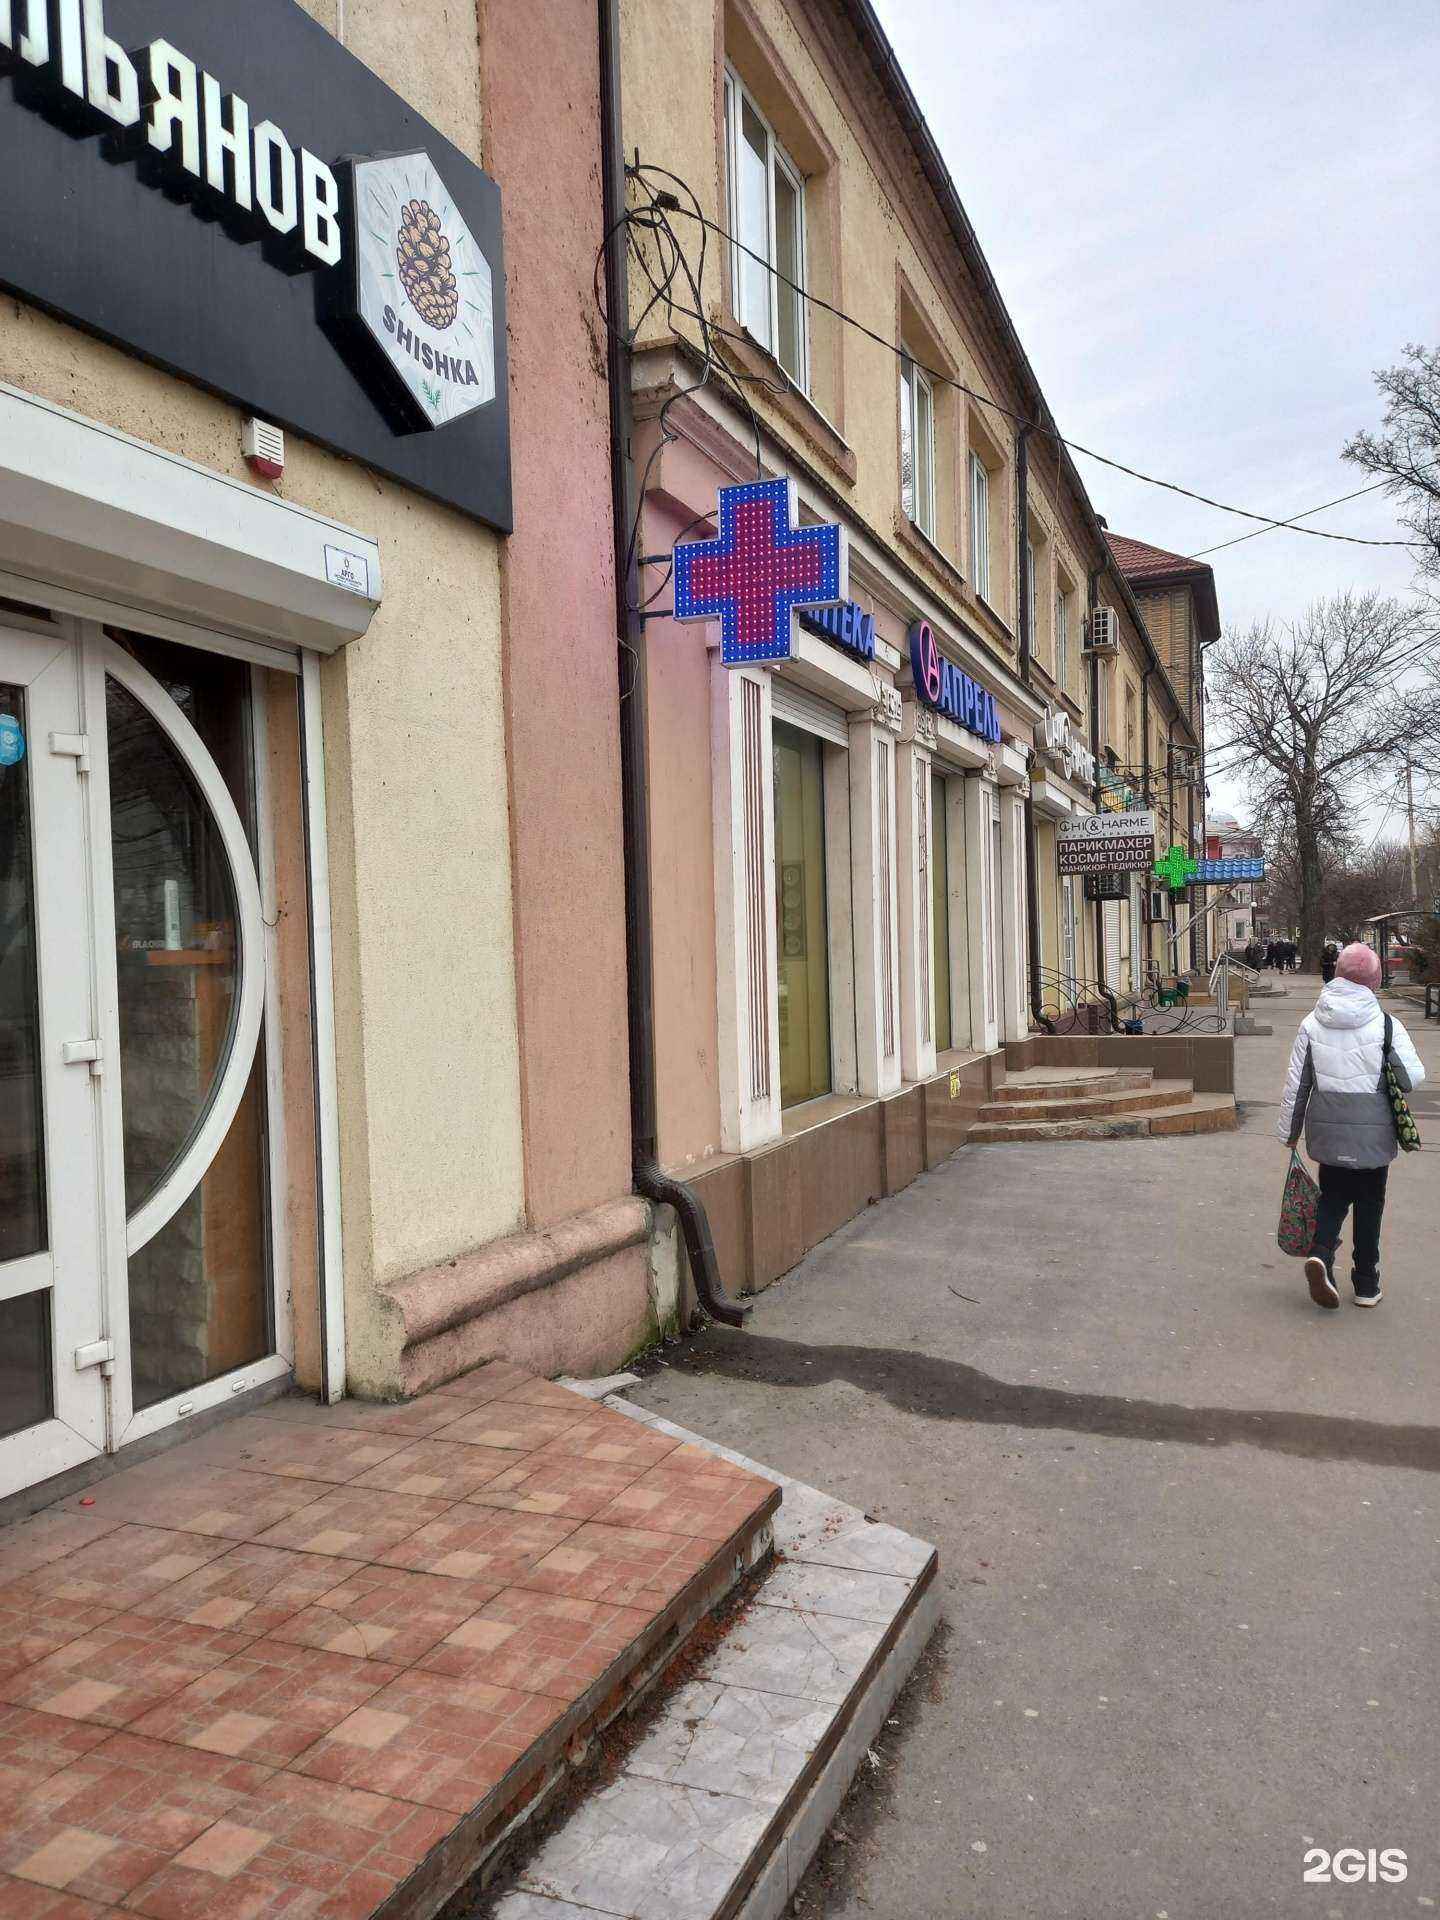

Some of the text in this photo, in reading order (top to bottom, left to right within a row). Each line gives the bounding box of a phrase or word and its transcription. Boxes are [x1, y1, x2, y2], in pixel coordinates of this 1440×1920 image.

[0, 0, 341, 266] ЛЬЯНОВ
[382, 304, 480, 386] SHISHKA
[941, 656, 1001, 743] АПРЕЛЬ
[1059, 837, 1152, 853] ПАРИКМАХЕР
[1059, 849, 1152, 865] КОСМЕТОЛОГ
